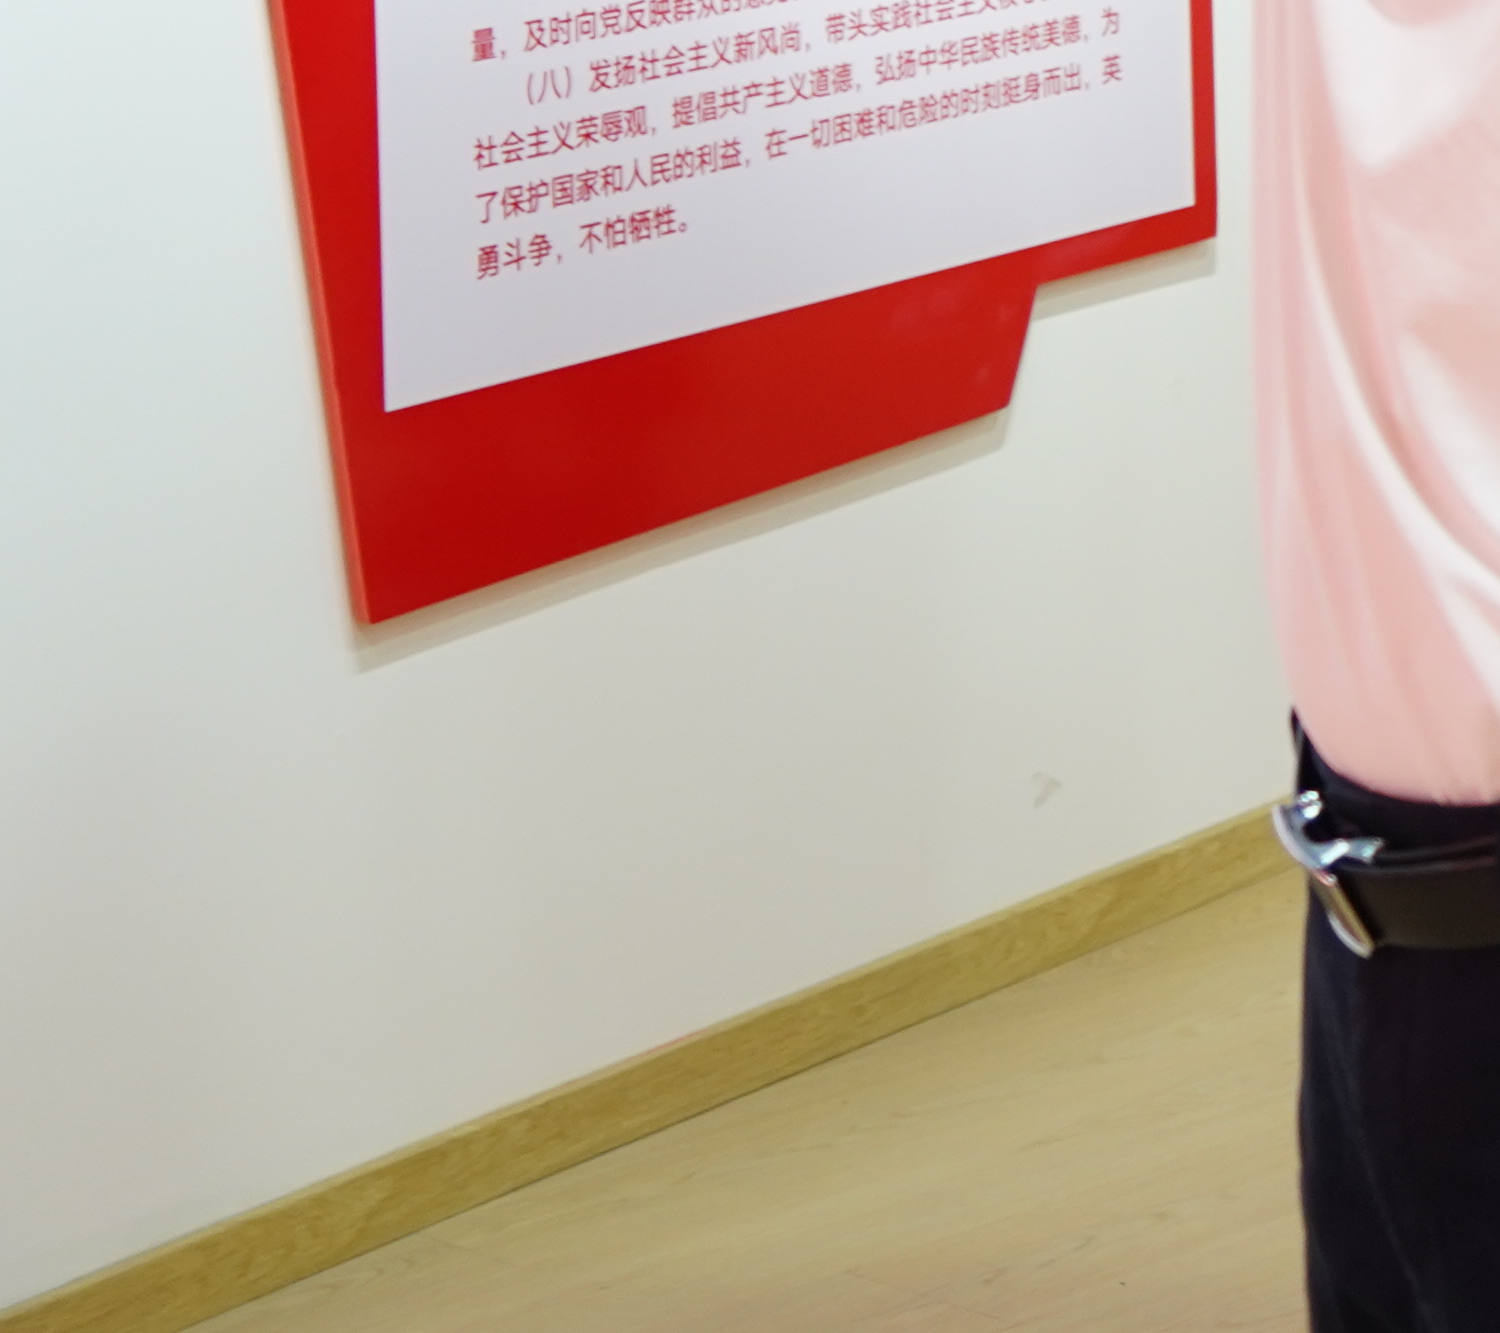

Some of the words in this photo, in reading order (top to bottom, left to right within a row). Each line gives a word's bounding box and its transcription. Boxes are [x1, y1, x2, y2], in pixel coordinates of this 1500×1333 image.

[476, 205, 690, 281] 勇斗争，不怕牺牲。
